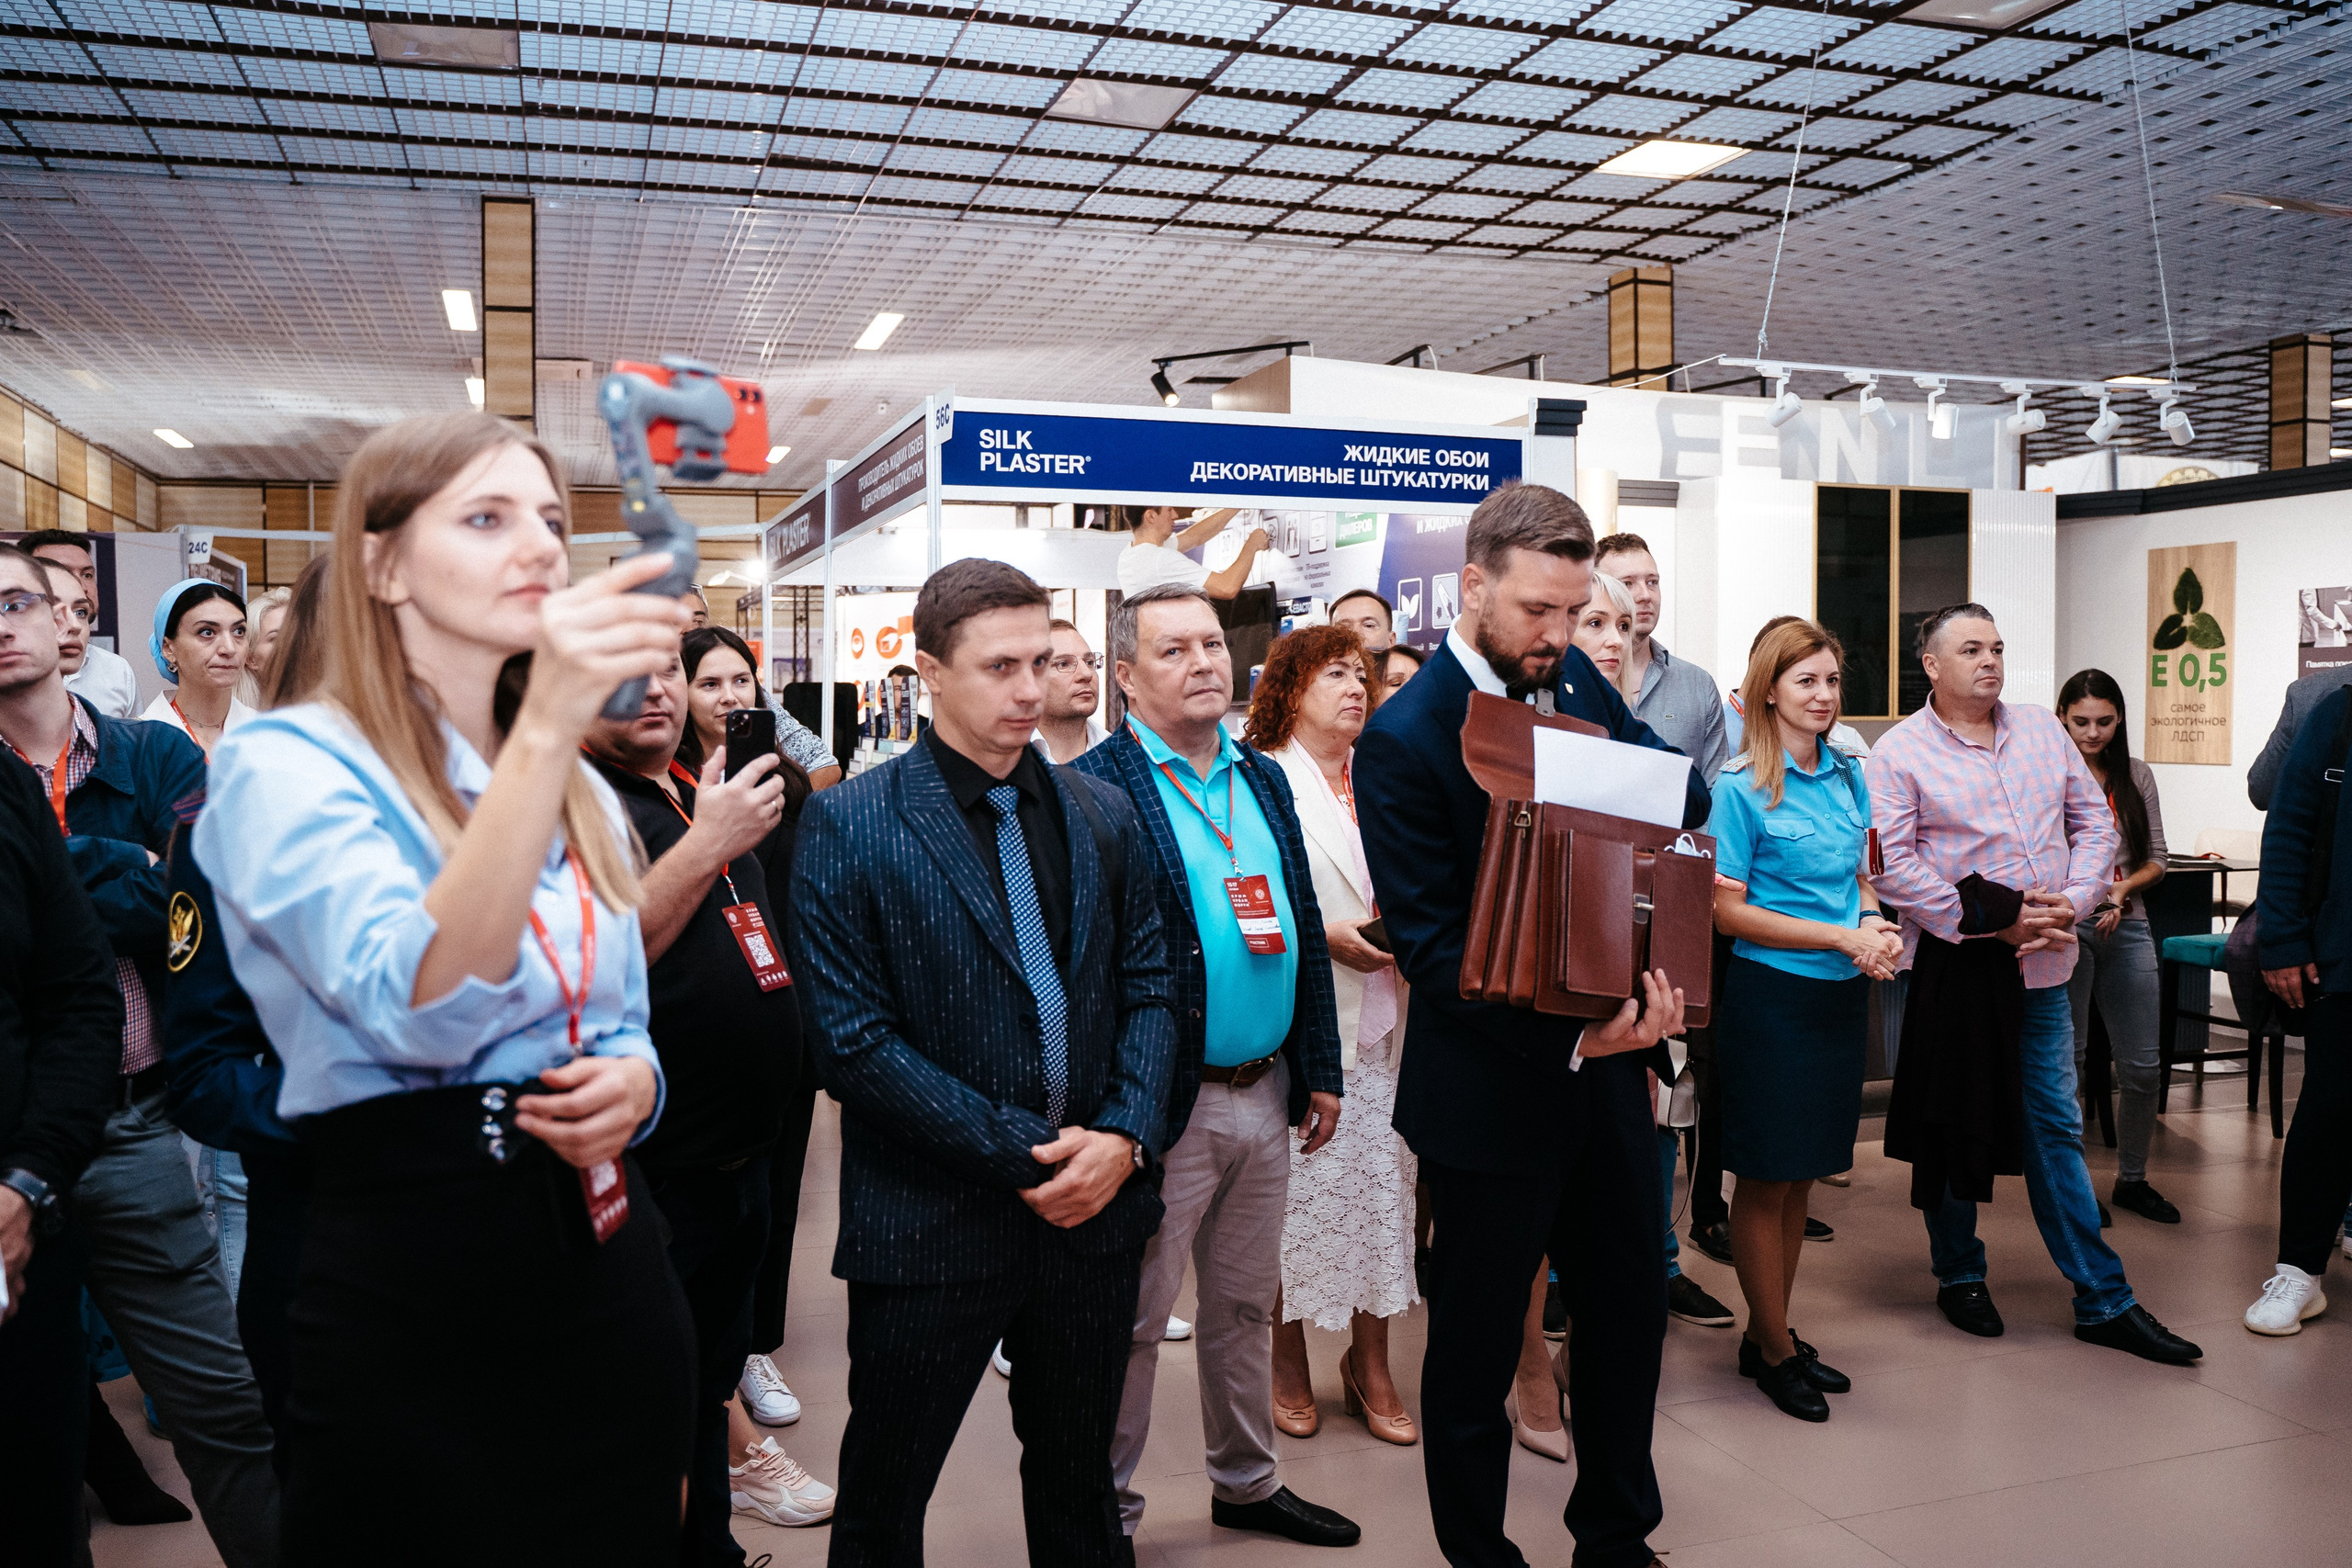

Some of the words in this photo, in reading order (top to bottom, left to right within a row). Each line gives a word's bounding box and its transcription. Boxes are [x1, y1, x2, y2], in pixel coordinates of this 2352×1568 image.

[935, 403, 950, 430] 56C
[979, 428, 1033, 450] SILK
[858, 459, 889, 493] ПРОИЗВОДИТЕЛЬ
[889, 446, 908, 471] ЖИДКИХ
[908, 434, 924, 459] ОБОЕВ
[1343, 445, 1430, 467] ЖИДКИЕ
[1435, 449, 1489, 468] ОБОИ
[865, 478, 894, 513] ДЕКОРАТИВНЫХ
[894, 457, 924, 491] ШТУКАТУРОК
[1190, 461, 1356, 487] ДЕКОРАТИВНЫЕ
[1360, 468, 1490, 491] ШТУКАТУРКИ
[782, 512, 810, 558] PLASTER
[1340, 518, 1374, 540] ДИЛЕРОВ
[1416, 520, 1423, 534] И
[1424, 515, 1464, 534] ЖИДКИХ
[188, 542, 208, 554] 24C
[2151, 654, 2168, 687] E
[2178, 652, 2227, 693] 0,5
[2306, 660, 2335, 669] Памятка
[2170, 703, 2206, 713] самое
[2151, 716, 2227, 727] экологичное
[2171, 730, 2205, 742] ЛДСП
